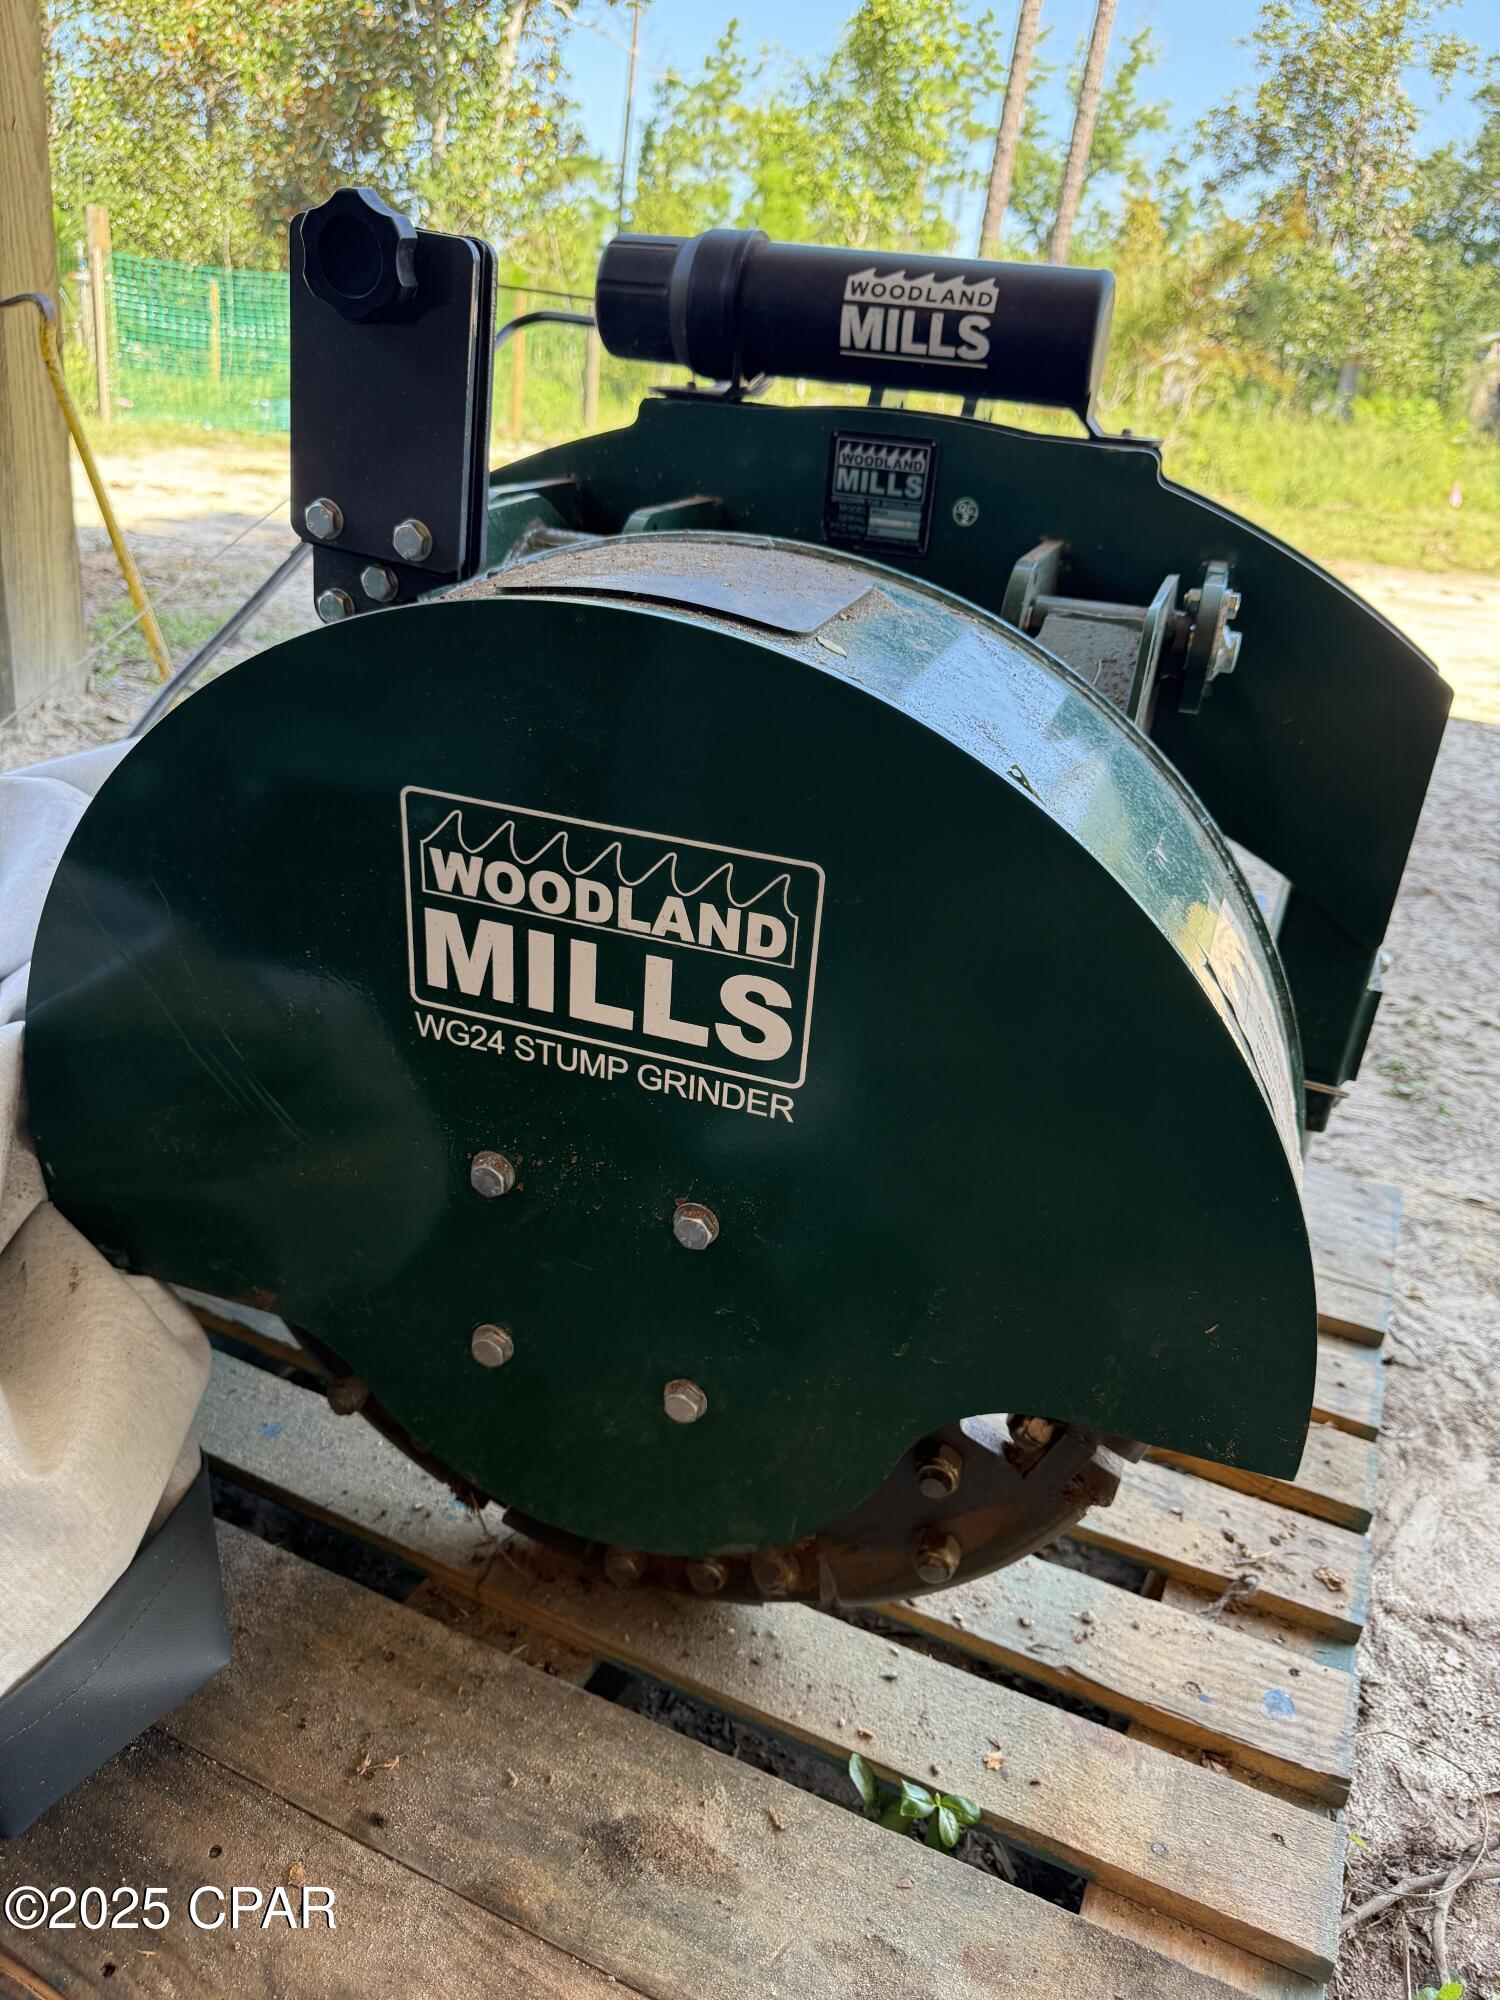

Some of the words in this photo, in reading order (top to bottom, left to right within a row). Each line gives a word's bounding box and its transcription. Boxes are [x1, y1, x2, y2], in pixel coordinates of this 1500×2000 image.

[851, 280, 993, 307] WOODLAND
[839, 303, 992, 361] MILLS
[836, 466, 923, 499] MILLS
[842, 453, 923, 472] WOODLAND
[429, 847, 788, 959] WOODLAND
[424, 907, 793, 1061] MILLS
[414, 1011, 505, 1054] WG24
[514, 1035, 629, 1080] STUMP
[637, 1063, 794, 1123] GRINDER
